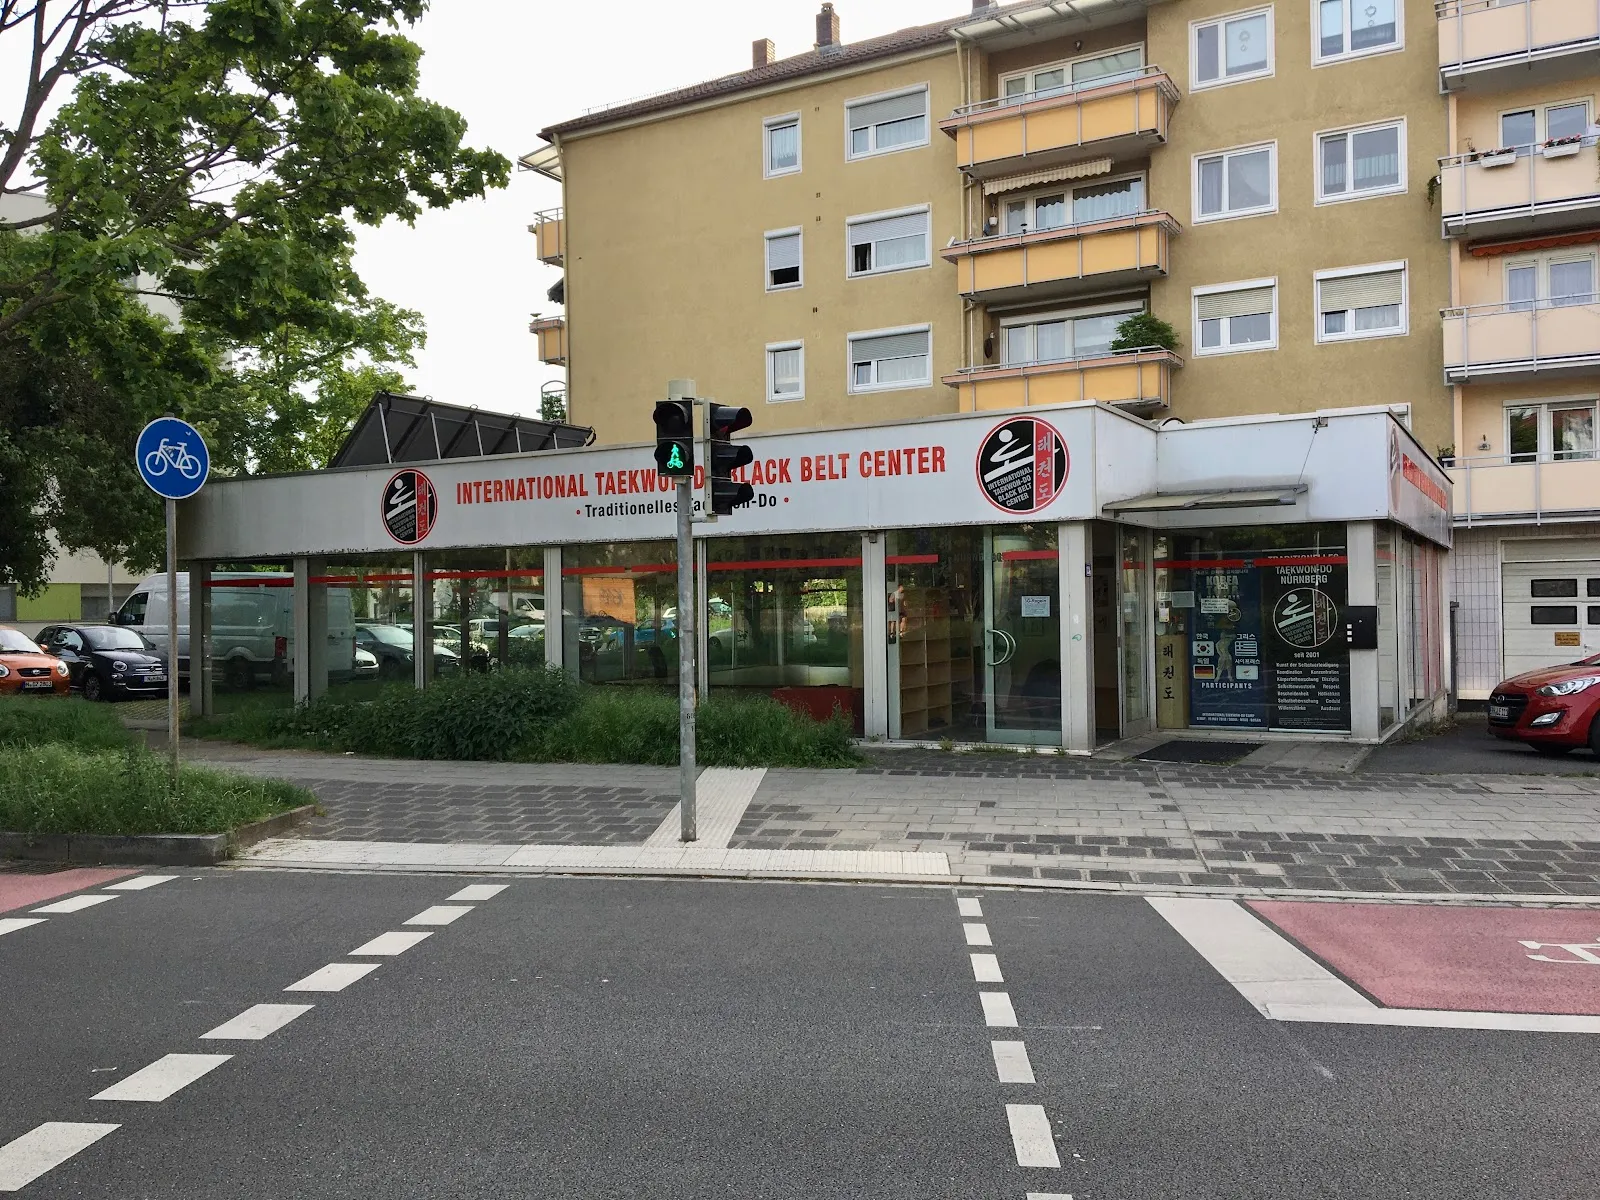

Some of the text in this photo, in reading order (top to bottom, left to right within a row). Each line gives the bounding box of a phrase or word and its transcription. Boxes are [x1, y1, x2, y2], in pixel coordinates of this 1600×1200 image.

[457, 473, 588, 504] INTERNATIONAL
[801, 453, 850, 482] BELT
[860, 446, 946, 478] CENTER
[987, 467, 1032, 490] INTERNATIONAL
[993, 475, 1032, 495] TAEKWON-DO
[997, 482, 1032, 502] BLACK BELT
[585, 499, 677, 518] Traditionelles
[1006, 493, 1029, 506] CENTER
[1275, 564, 1333, 574] TAEKWON-DO
[1280, 573, 1328, 584] NÜRNBERG
